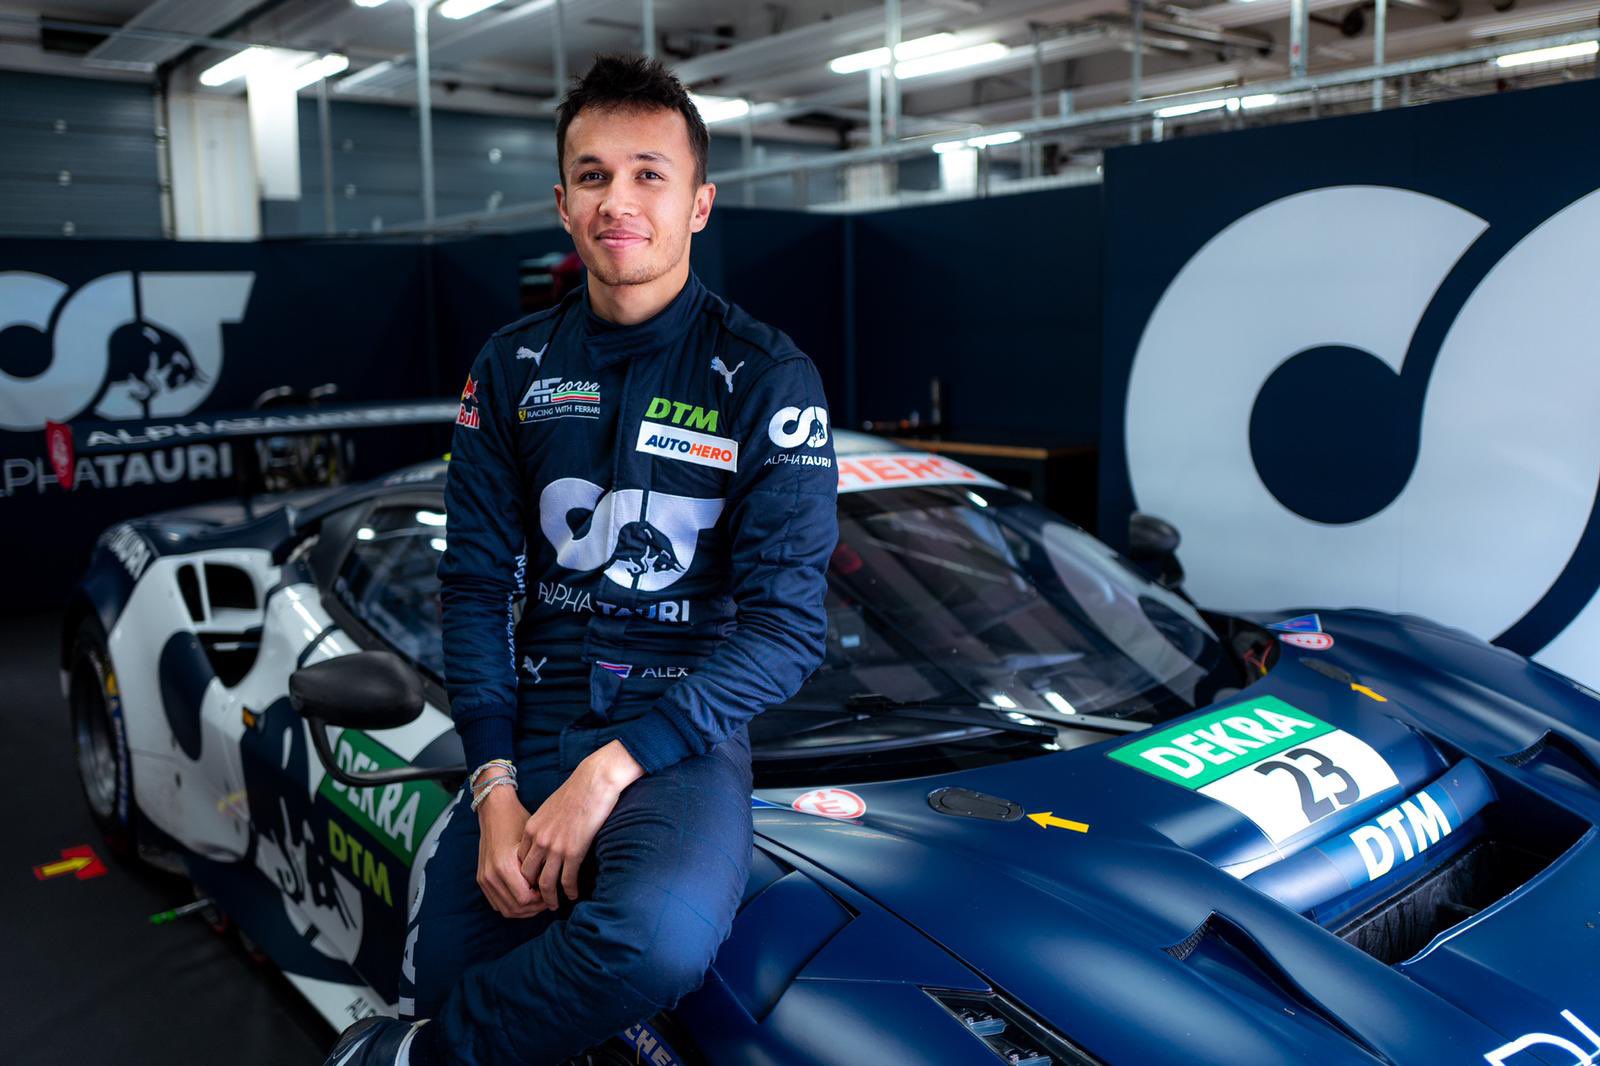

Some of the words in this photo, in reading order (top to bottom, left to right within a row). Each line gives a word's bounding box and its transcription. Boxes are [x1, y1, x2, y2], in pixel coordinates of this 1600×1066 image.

[527, 407, 554, 418] RACING
[554, 404, 573, 415] WITH
[644, 397, 719, 432] DTM
[0, 442, 234, 497] PHATAURI
[645, 434, 733, 463] AUTOHERO
[763, 453, 832, 469] ALPHATAURI
[641, 666, 689, 678] ALEX
[1139, 708, 1316, 779] DEKRA
[332, 739, 421, 852] DEKRA
[1254, 747, 1361, 823] 23
[328, 818, 393, 908] DTM
[1349, 791, 1453, 881] DTM
